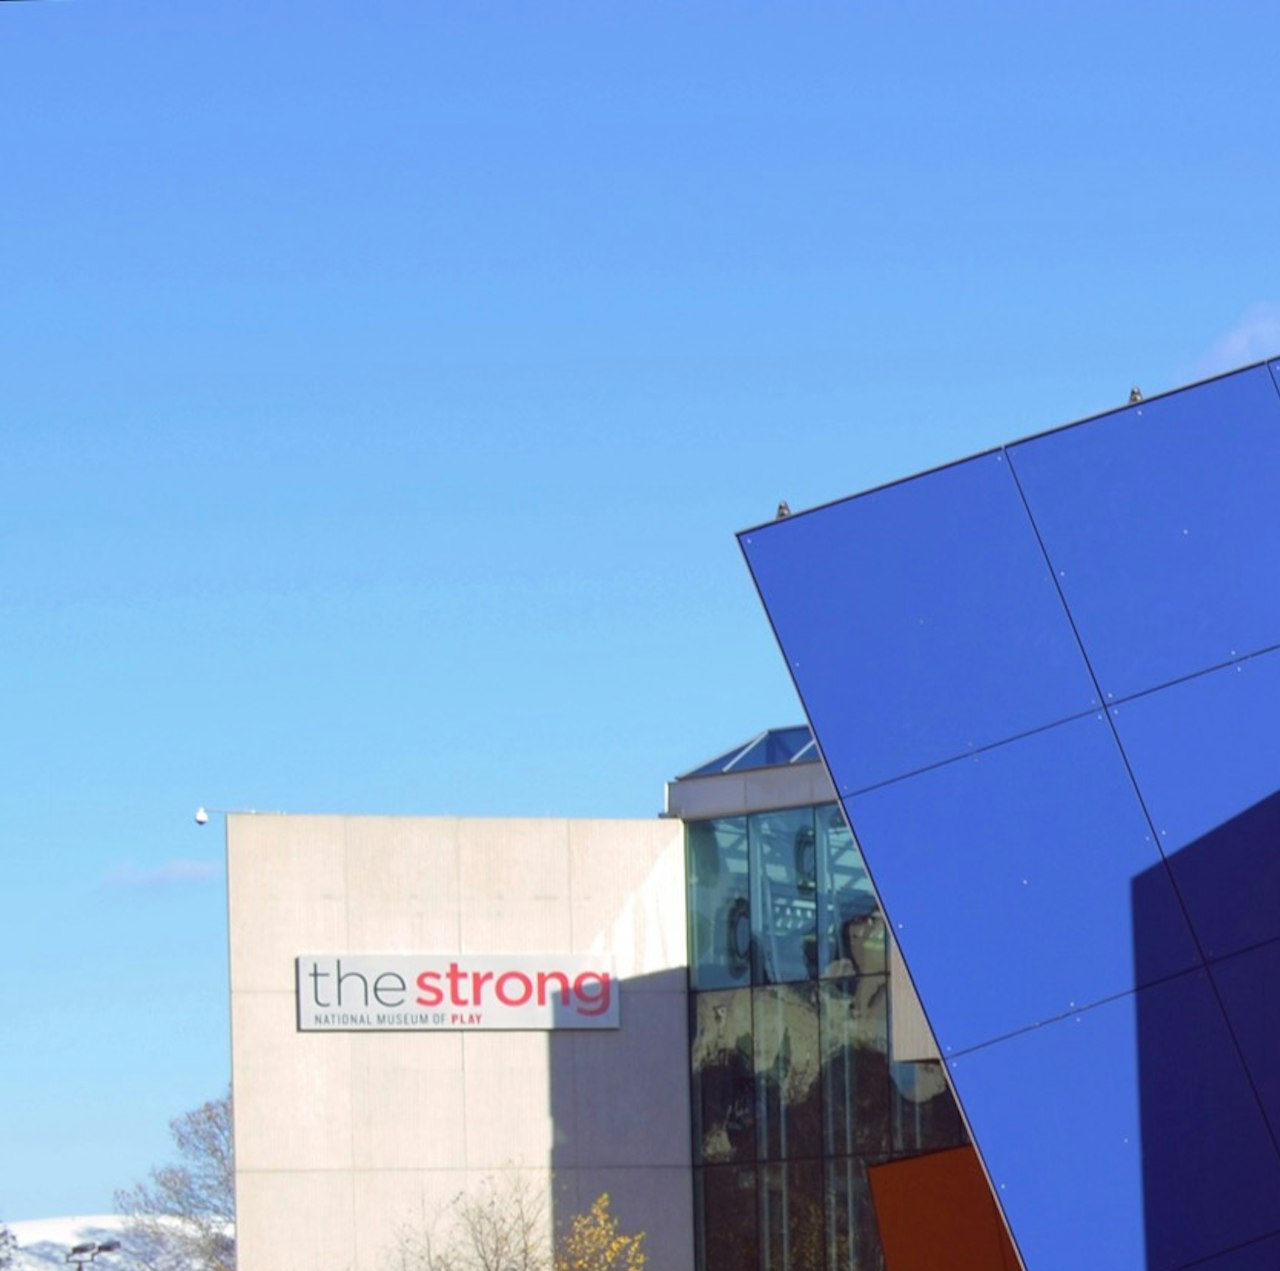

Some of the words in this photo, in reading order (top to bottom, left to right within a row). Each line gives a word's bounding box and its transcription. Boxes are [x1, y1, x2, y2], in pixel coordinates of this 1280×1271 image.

[309, 958, 407, 1008] the
[416, 962, 611, 1017] strong
[314, 1013, 372, 1025] NATIONAL
[376, 1013, 429, 1025] MUSEUM
[432, 1013, 446, 1025] OF
[451, 1013, 483, 1025] PLAY
